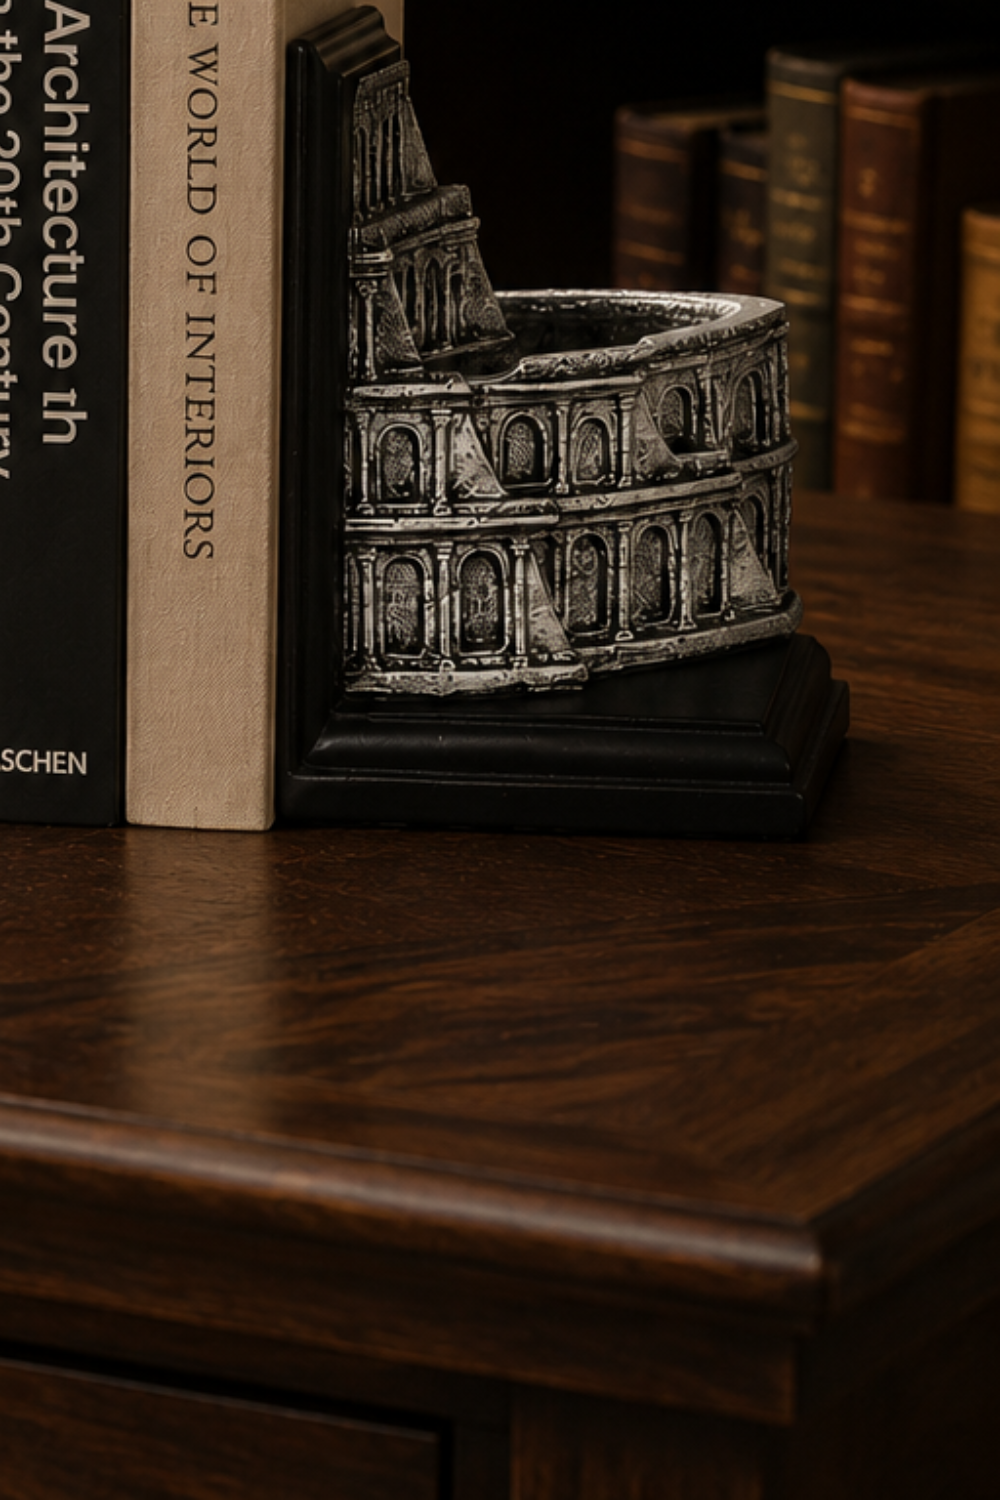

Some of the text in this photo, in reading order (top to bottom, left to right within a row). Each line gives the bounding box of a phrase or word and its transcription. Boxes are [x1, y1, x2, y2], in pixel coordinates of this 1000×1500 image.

[186, 42, 219, 216] WORLD
[185, 234, 218, 296] OF
[182, 311, 217, 560] INTERIORS
